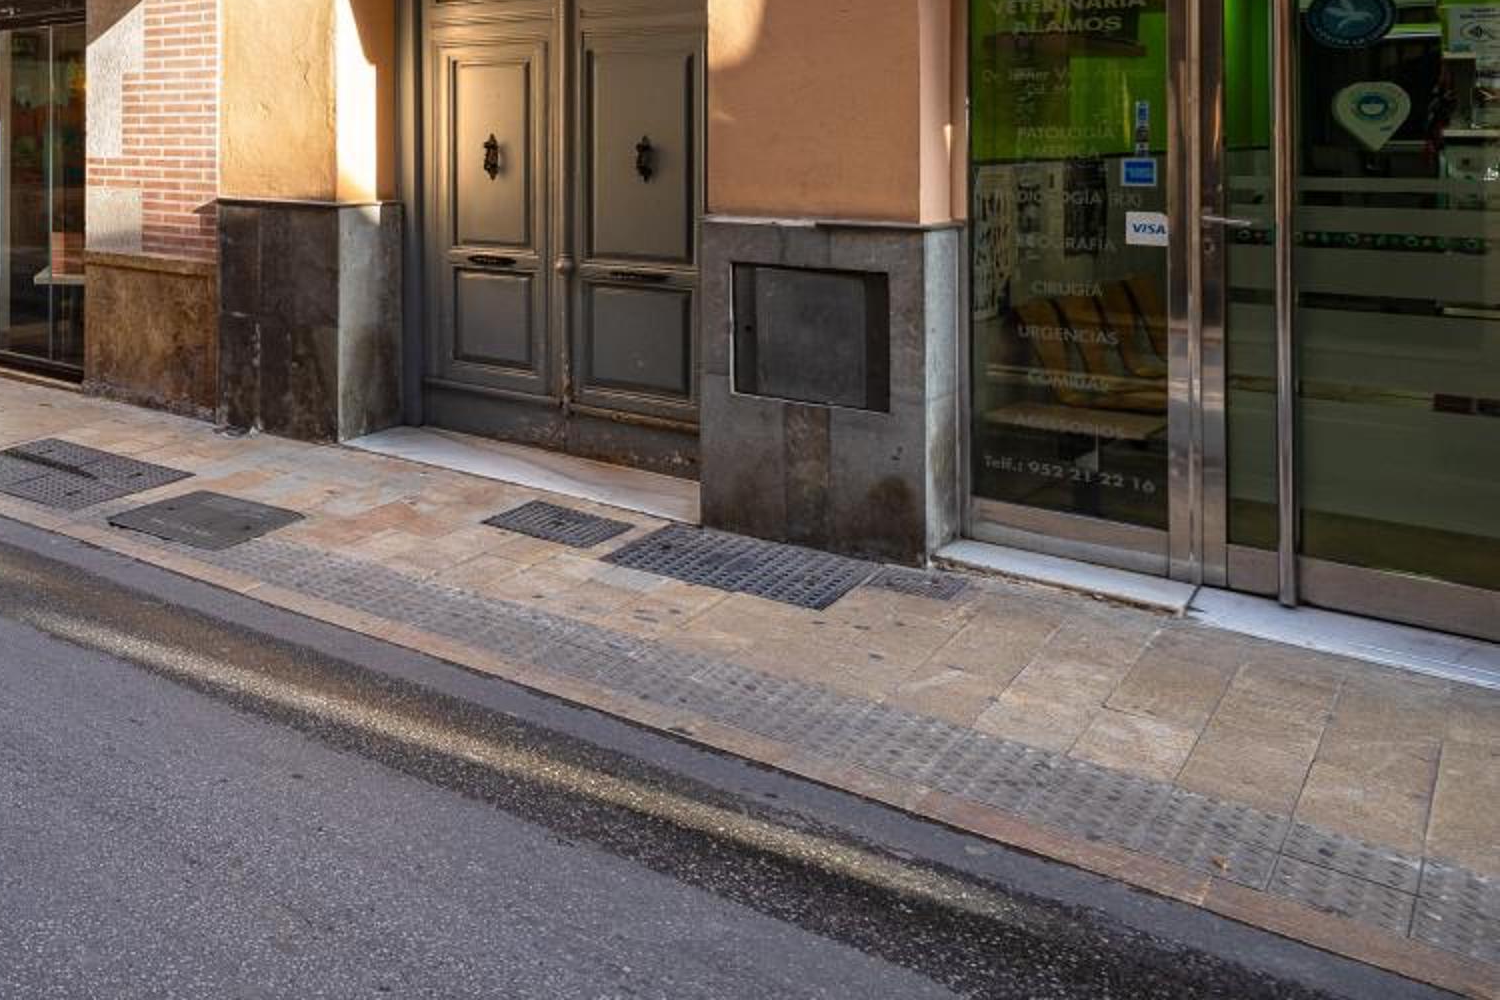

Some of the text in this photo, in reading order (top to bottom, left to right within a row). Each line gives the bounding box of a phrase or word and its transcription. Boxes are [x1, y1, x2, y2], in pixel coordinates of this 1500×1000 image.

[1132, 223, 1166, 235] VISA
[1017, 325, 1119, 345] URGENCIAS
[1027, 460, 1064, 478] 952
[1099, 473, 1125, 488] 22
[1132, 478, 1157, 494] 16
